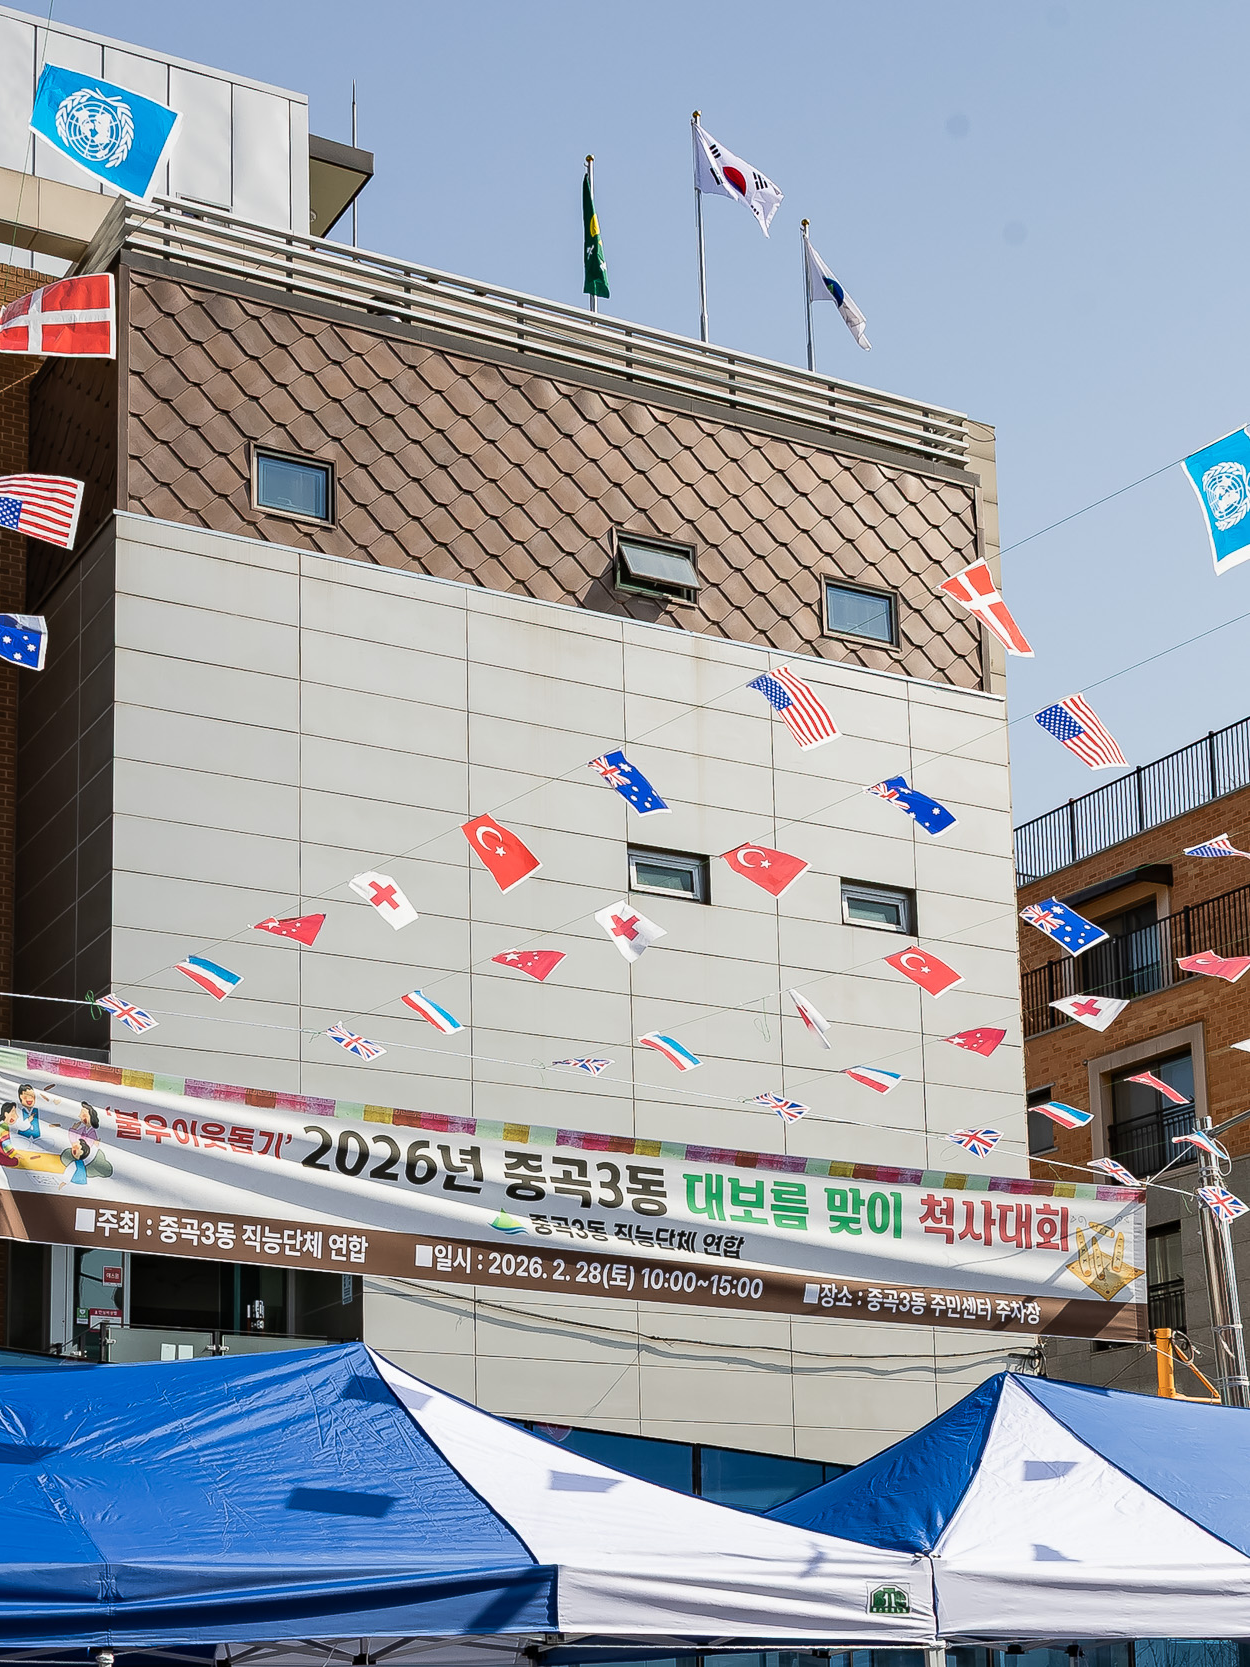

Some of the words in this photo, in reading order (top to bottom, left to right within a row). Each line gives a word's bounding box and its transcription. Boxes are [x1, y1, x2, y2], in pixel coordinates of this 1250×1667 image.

[301, 1125, 484, 1195] 2026년
[503, 1150, 668, 1217] 중곡3동
[682, 1172, 810, 1234] 대보름
[824, 1186, 903, 1241] 맞이
[918, 1193, 1070, 1254] 척사대회
[96, 1208, 139, 1240] 주최
[158, 1215, 237, 1250] 중곡3동
[241, 1224, 323, 1260] 직능단체
[328, 1233, 369, 1264] 연합
[527, 1213, 609, 1242] 중곡3동
[613, 1222, 698, 1253] 직능단체
[702, 1233, 745, 1260] 연합
[434, 1244, 471, 1274] 일시
[575, 1261, 635, 1291] 28(토)
[641, 1267, 764, 1299] 10:00~15:00
[820, 1282, 853, 1307] 장소
[866, 1287, 927, 1316] 중곡3동
[930, 1293, 992, 1321] 주민센터
[995, 1299, 1042, 1325] 주차장
